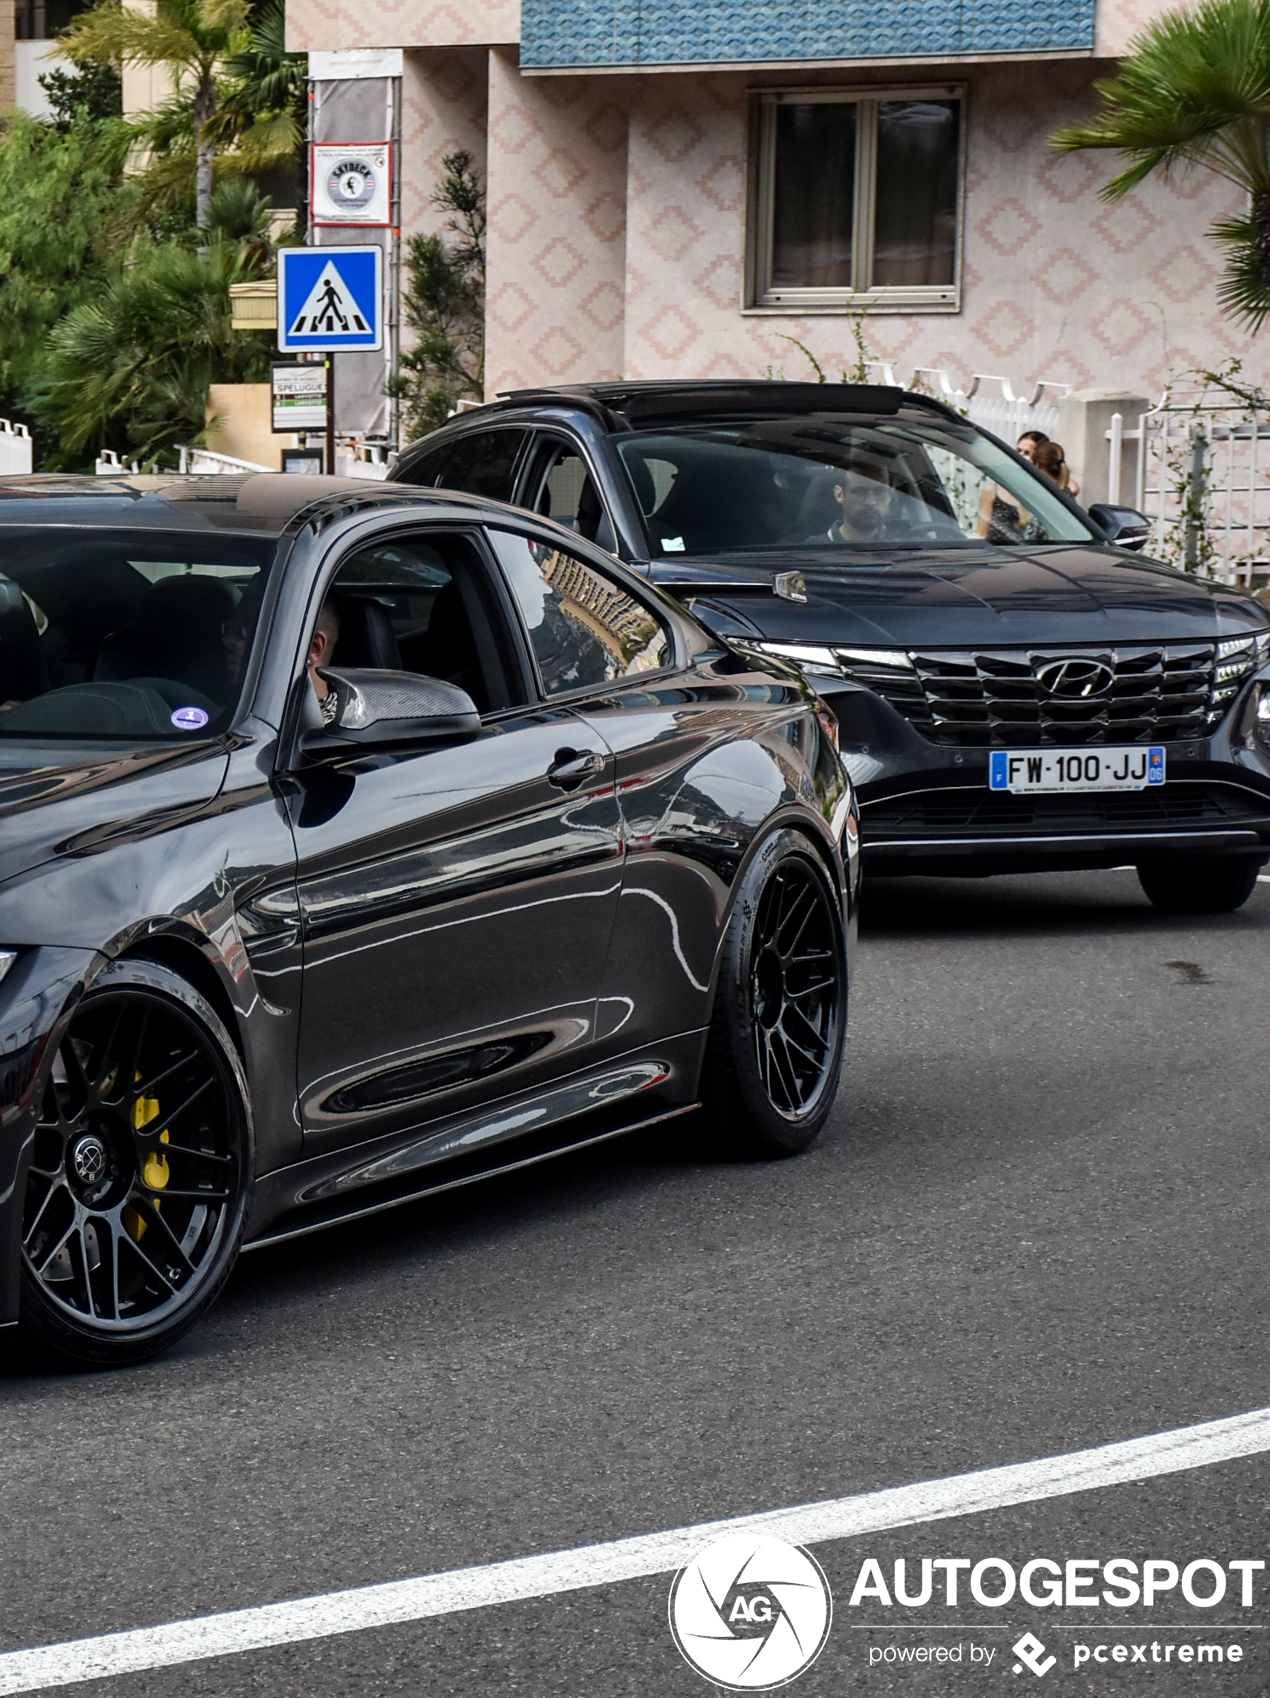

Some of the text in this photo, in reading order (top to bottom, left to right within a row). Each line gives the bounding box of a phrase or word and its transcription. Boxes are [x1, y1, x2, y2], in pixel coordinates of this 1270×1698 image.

[332, 163, 372, 179] SKYDECK
[185, 711, 195, 720] 1
[1008, 754, 1146, 784] FW-100-JJ
[1149, 767, 1163, 781] 06
[996, 773, 1002, 782] F
